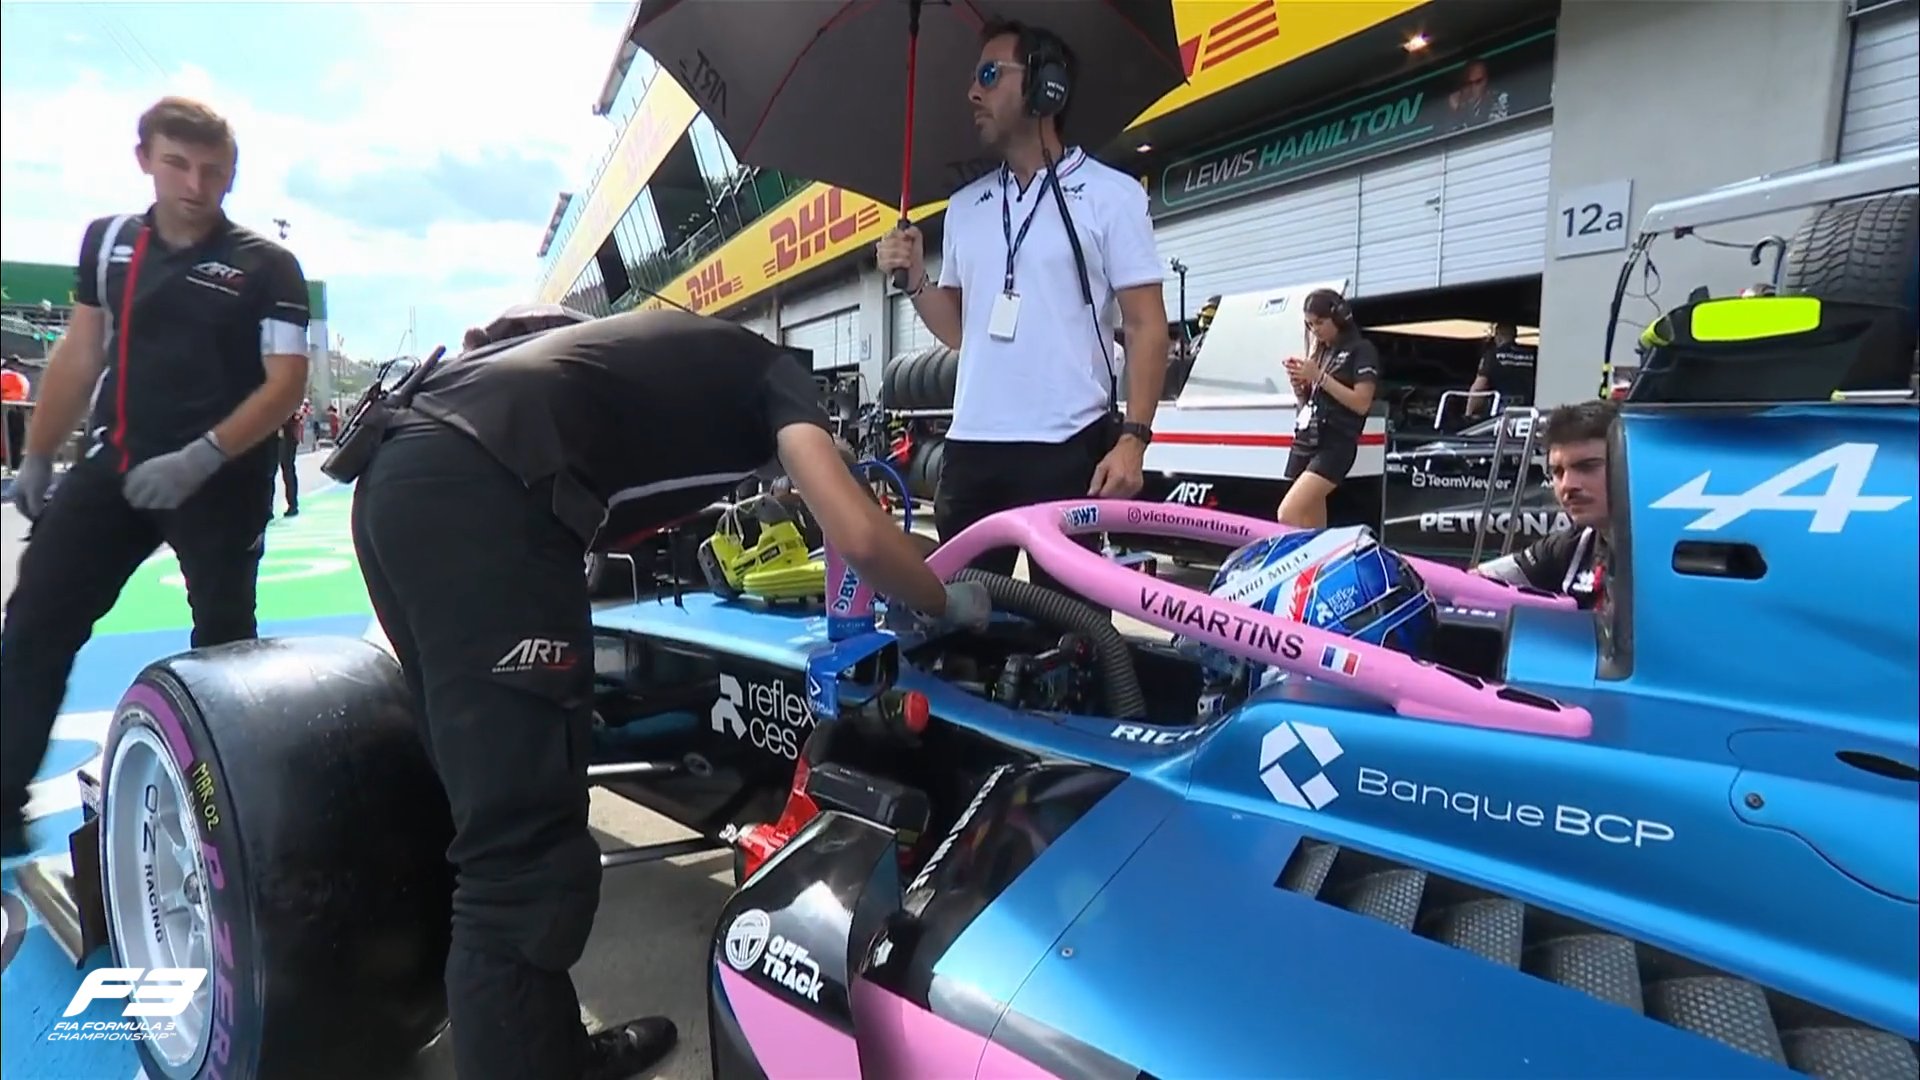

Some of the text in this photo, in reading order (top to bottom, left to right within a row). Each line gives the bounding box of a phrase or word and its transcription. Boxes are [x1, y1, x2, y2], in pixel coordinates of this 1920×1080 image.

[1184, 92, 1424, 192] LEWIS HAMILTON
[769, 186, 857, 273] DHL
[1562, 203, 1623, 238] 12a
[686, 257, 733, 311] DHL
[1494, 417, 1533, 438] INE
[1164, 482, 1213, 506] ART
[1070, 506, 1099, 527] BWT
[1142, 508, 1250, 537] victormartinsfr
[1420, 512, 1573, 535] PETRONA
[1140, 587, 1305, 661] V.MARTINS
[497, 638, 570, 667] ART
[748, 679, 816, 729] reflex
[750, 718, 798, 760] ces
[192, 762, 214, 803] MAR
[1357, 766, 1675, 847] Banque BCP
[144, 863, 163, 944] RACING
[768, 934, 809, 966] OFF
[763, 952, 824, 1003] TRACK
